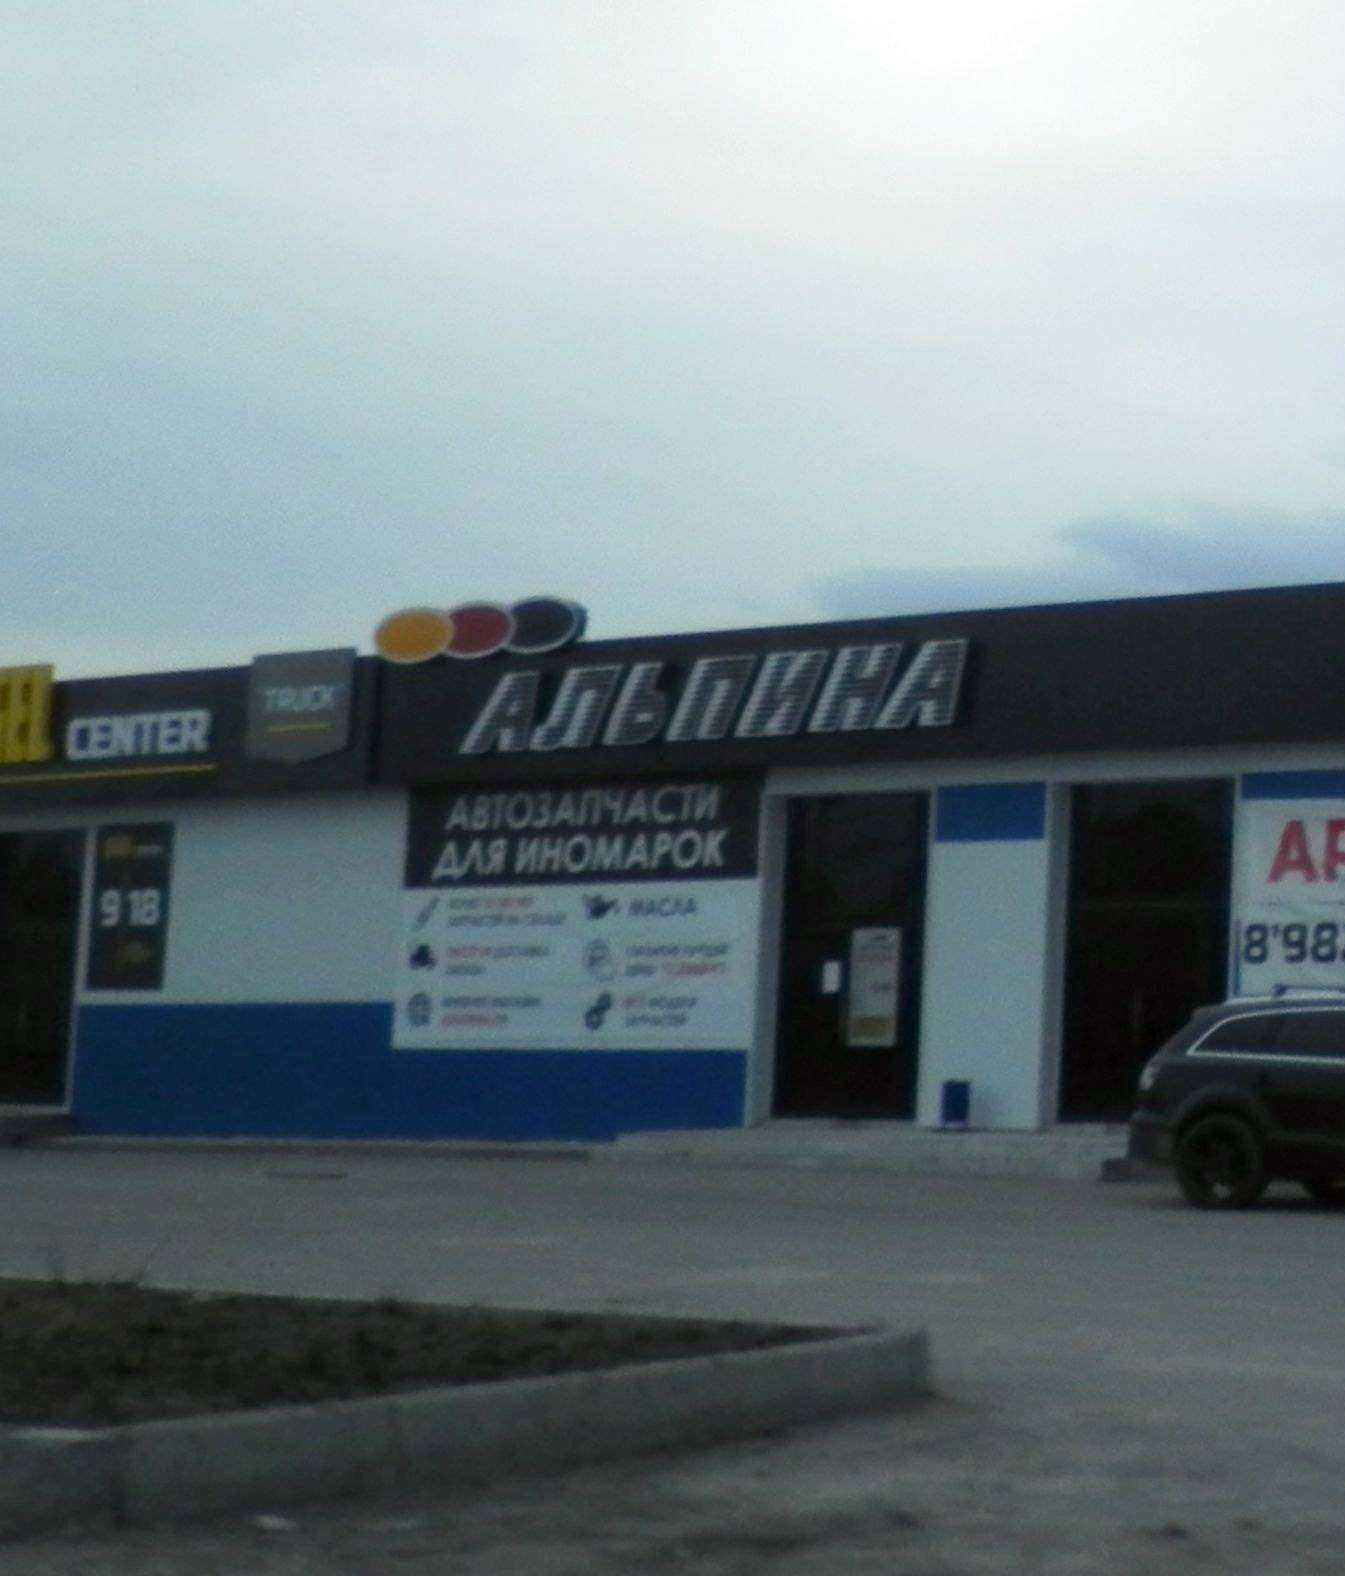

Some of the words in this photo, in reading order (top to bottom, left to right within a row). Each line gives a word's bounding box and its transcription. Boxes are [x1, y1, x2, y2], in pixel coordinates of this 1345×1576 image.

[458, 638, 970, 755] АЛЬПИНА
[67, 708, 211, 761] CENTER
[445, 785, 722, 832] АВТОЗАПЧАСТИ
[432, 836, 508, 881] ДЛЯ
[513, 828, 730, 875] ИНОМАРОК
[101, 888, 121, 927] 9
[128, 886, 160, 926] 18
